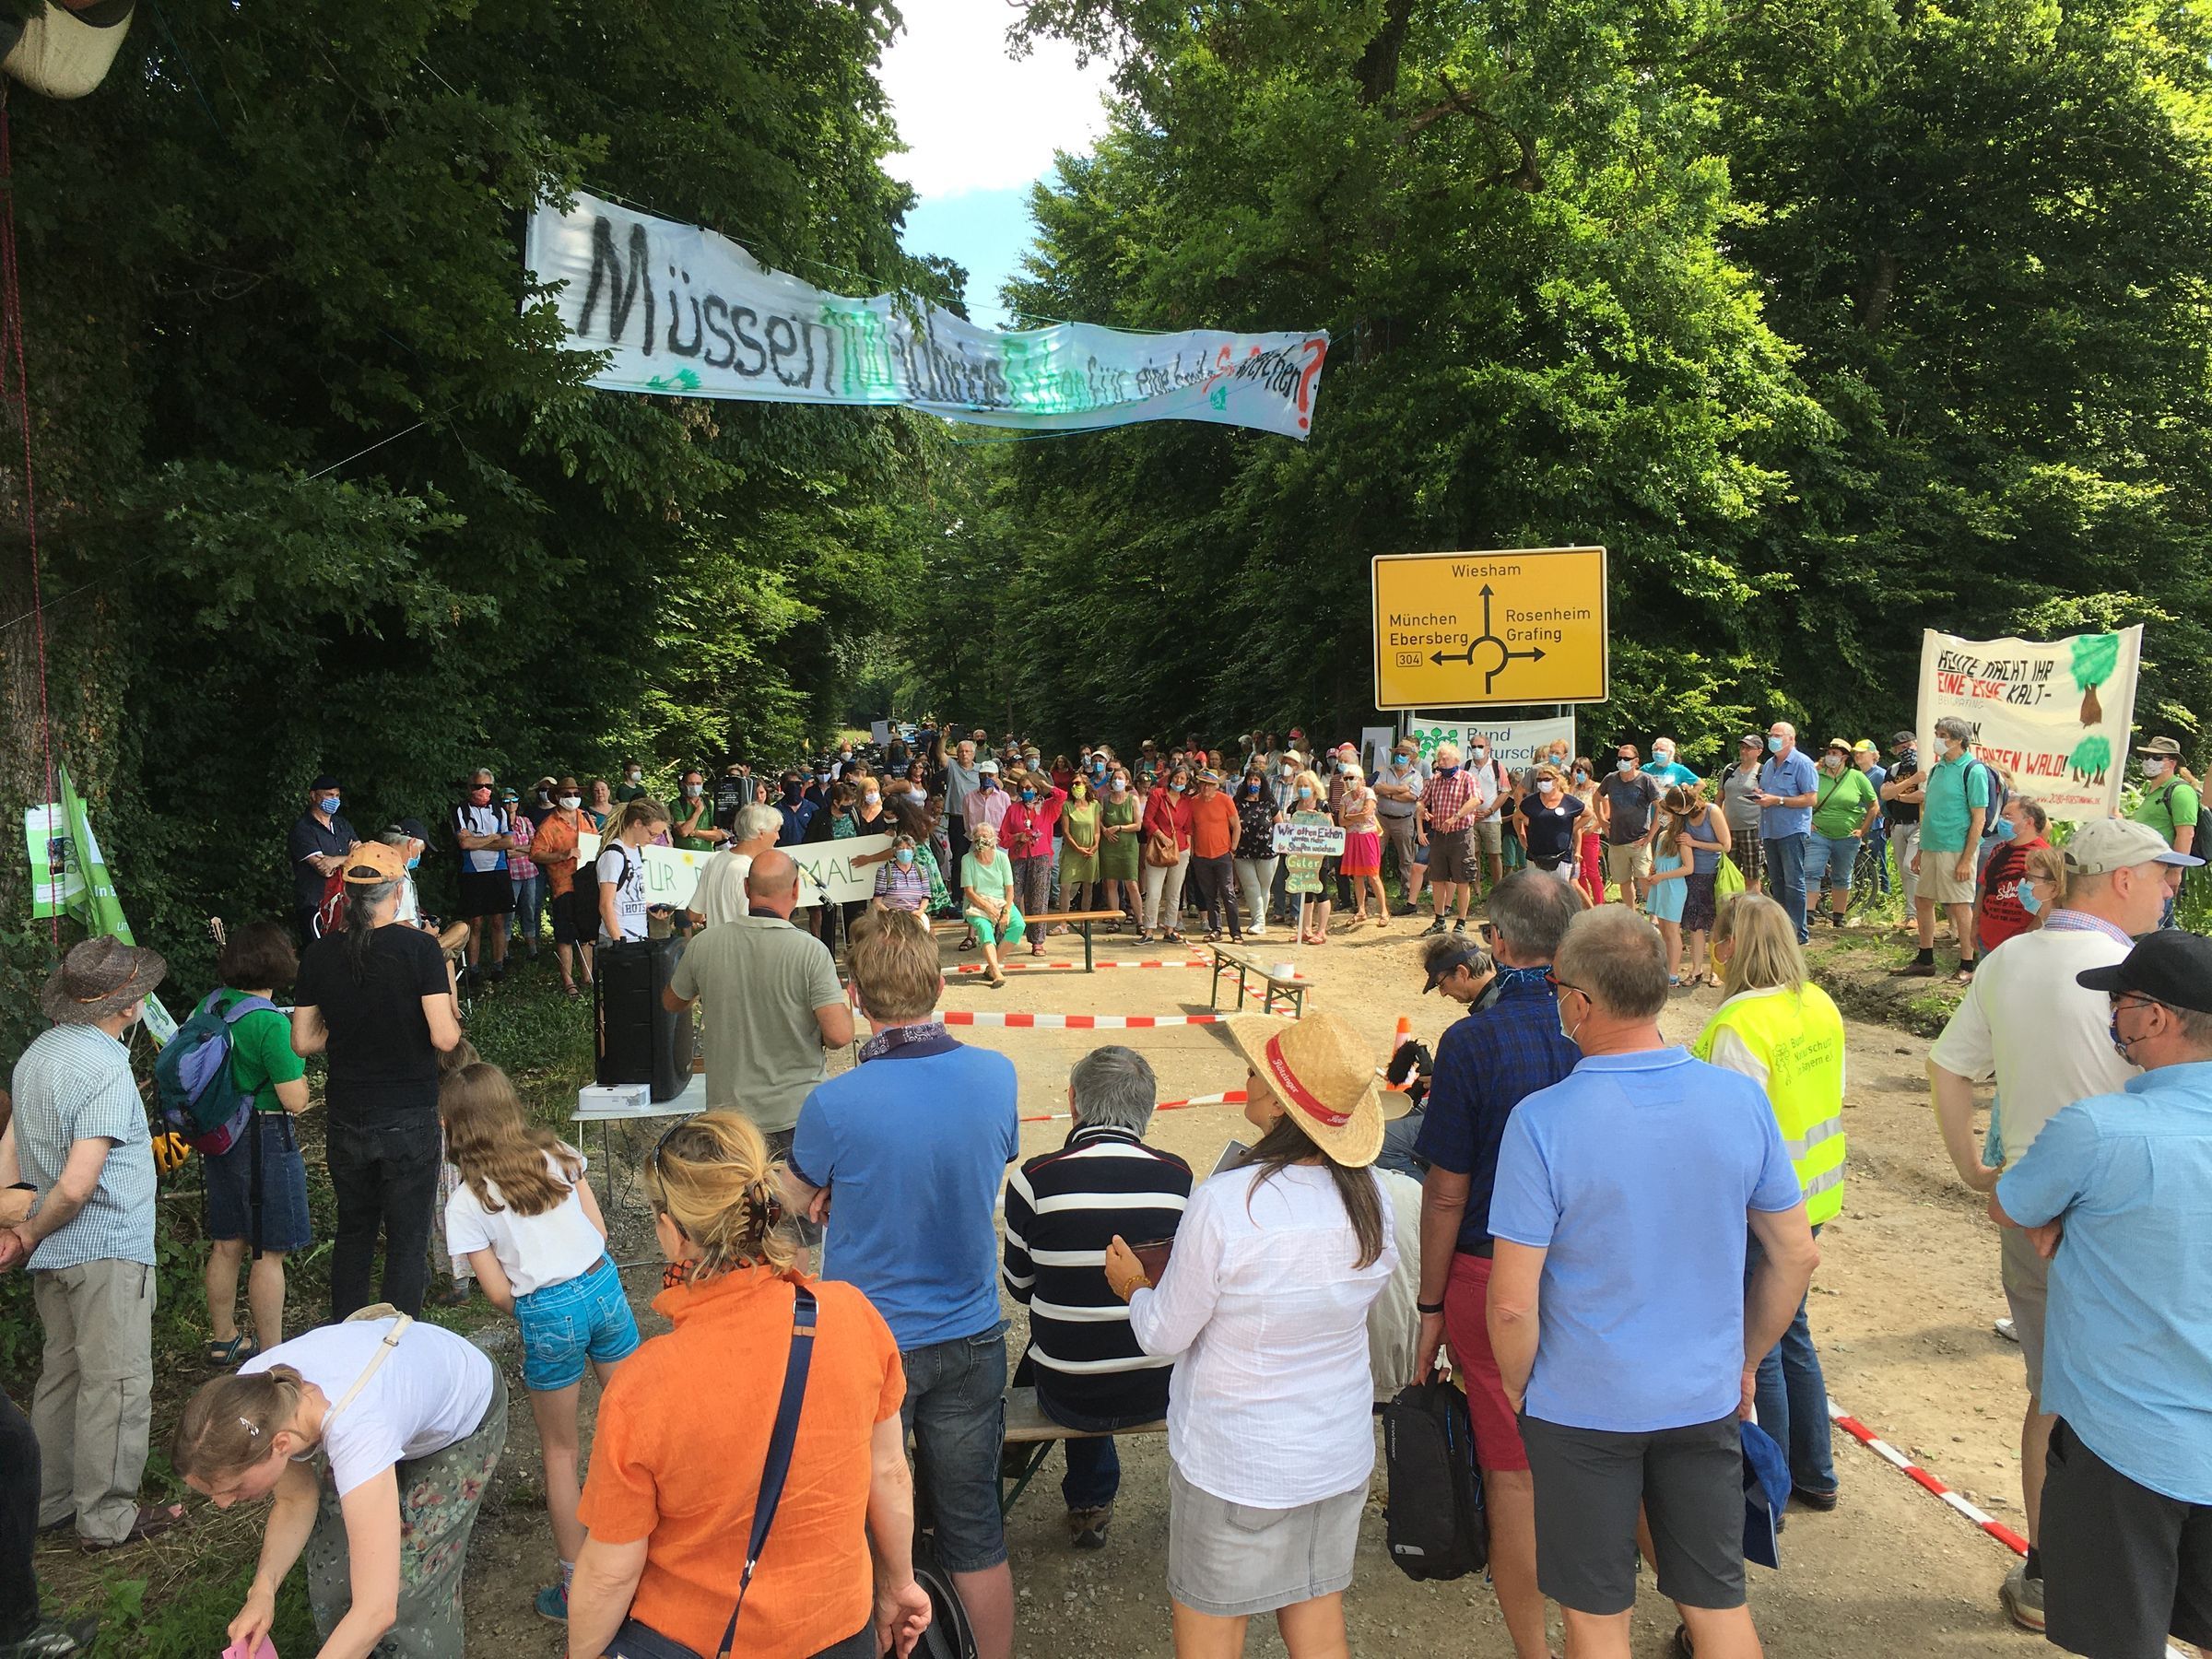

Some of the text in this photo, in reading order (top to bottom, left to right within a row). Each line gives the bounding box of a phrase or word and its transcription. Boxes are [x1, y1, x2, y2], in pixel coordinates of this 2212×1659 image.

[577, 216, 837, 396] Müssen
[1452, 563, 1522, 578] Wiesham
[1389, 613, 1457, 627] München
[1506, 607, 1591, 622] Rosenheim
[1389, 631, 1469, 647] Ebersberg
[1506, 628, 1562, 643] Grafing
[1398, 654, 1420, 665] 304
[1937, 650, 2054, 682] HEUTE MACHT IHR
[1937, 672, 1968, 696] EINE
[1467, 727, 1511, 742] Bnd
[1277, 824, 1295, 836] Wir
[641, 857, 677, 891] UR
[94, 885, 107, 897] In
